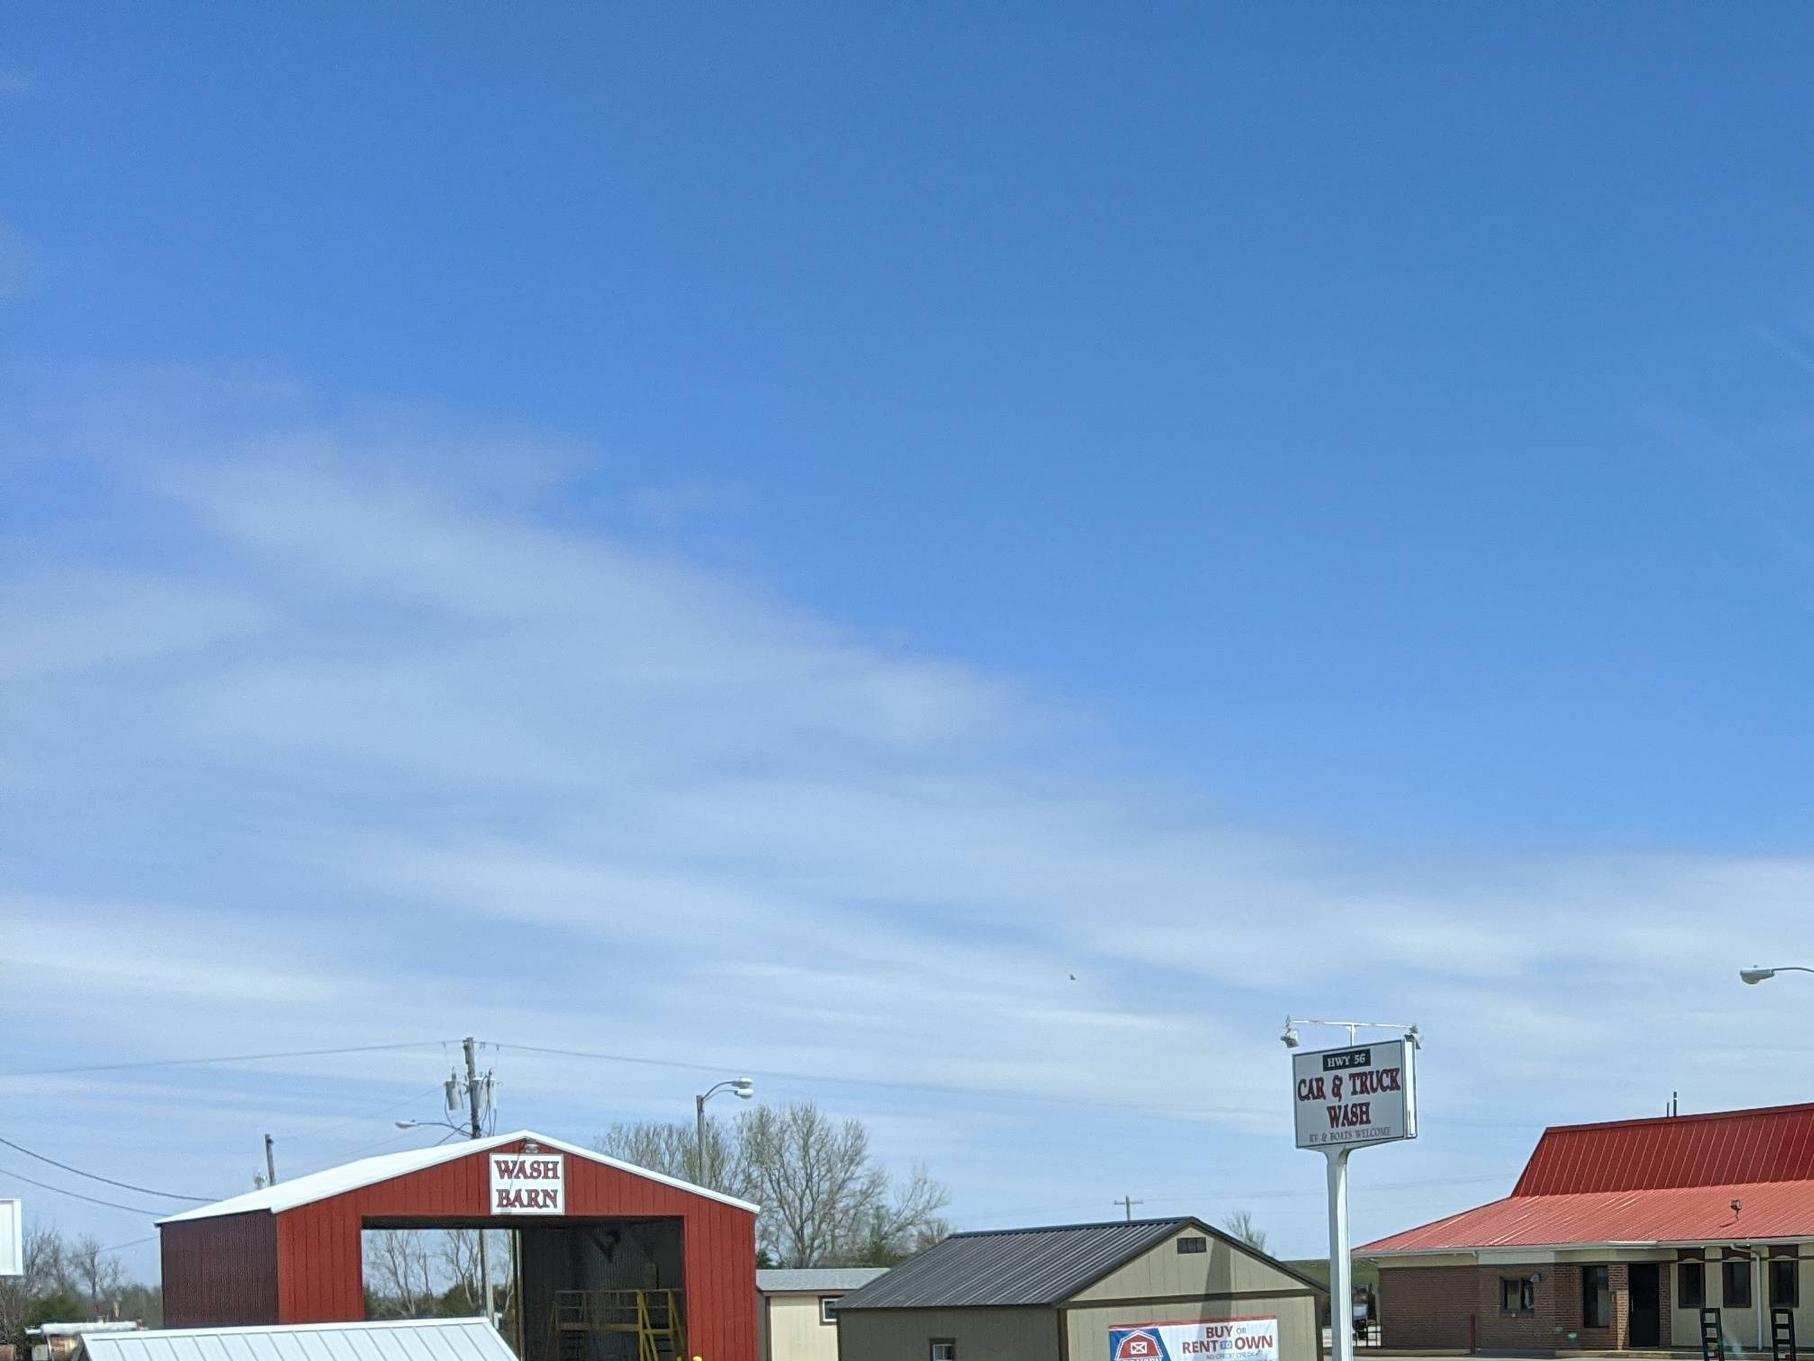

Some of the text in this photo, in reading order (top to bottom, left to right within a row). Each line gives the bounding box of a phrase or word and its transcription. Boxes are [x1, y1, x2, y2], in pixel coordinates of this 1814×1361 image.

[1327, 1053, 1366, 1068] HWY 56
[1297, 1067, 1401, 1102] CAR & TRUCK
[1326, 1102, 1372, 1129] WASH
[1355, 1126, 1392, 1139] WELCOME
[494, 1160, 560, 1180] WASH
[496, 1189, 558, 1209] BARN
[1205, 1325, 1247, 1339] BUY OR
[1182, 1340, 1218, 1354] RENT
[1234, 1335, 1273, 1350] OWN
